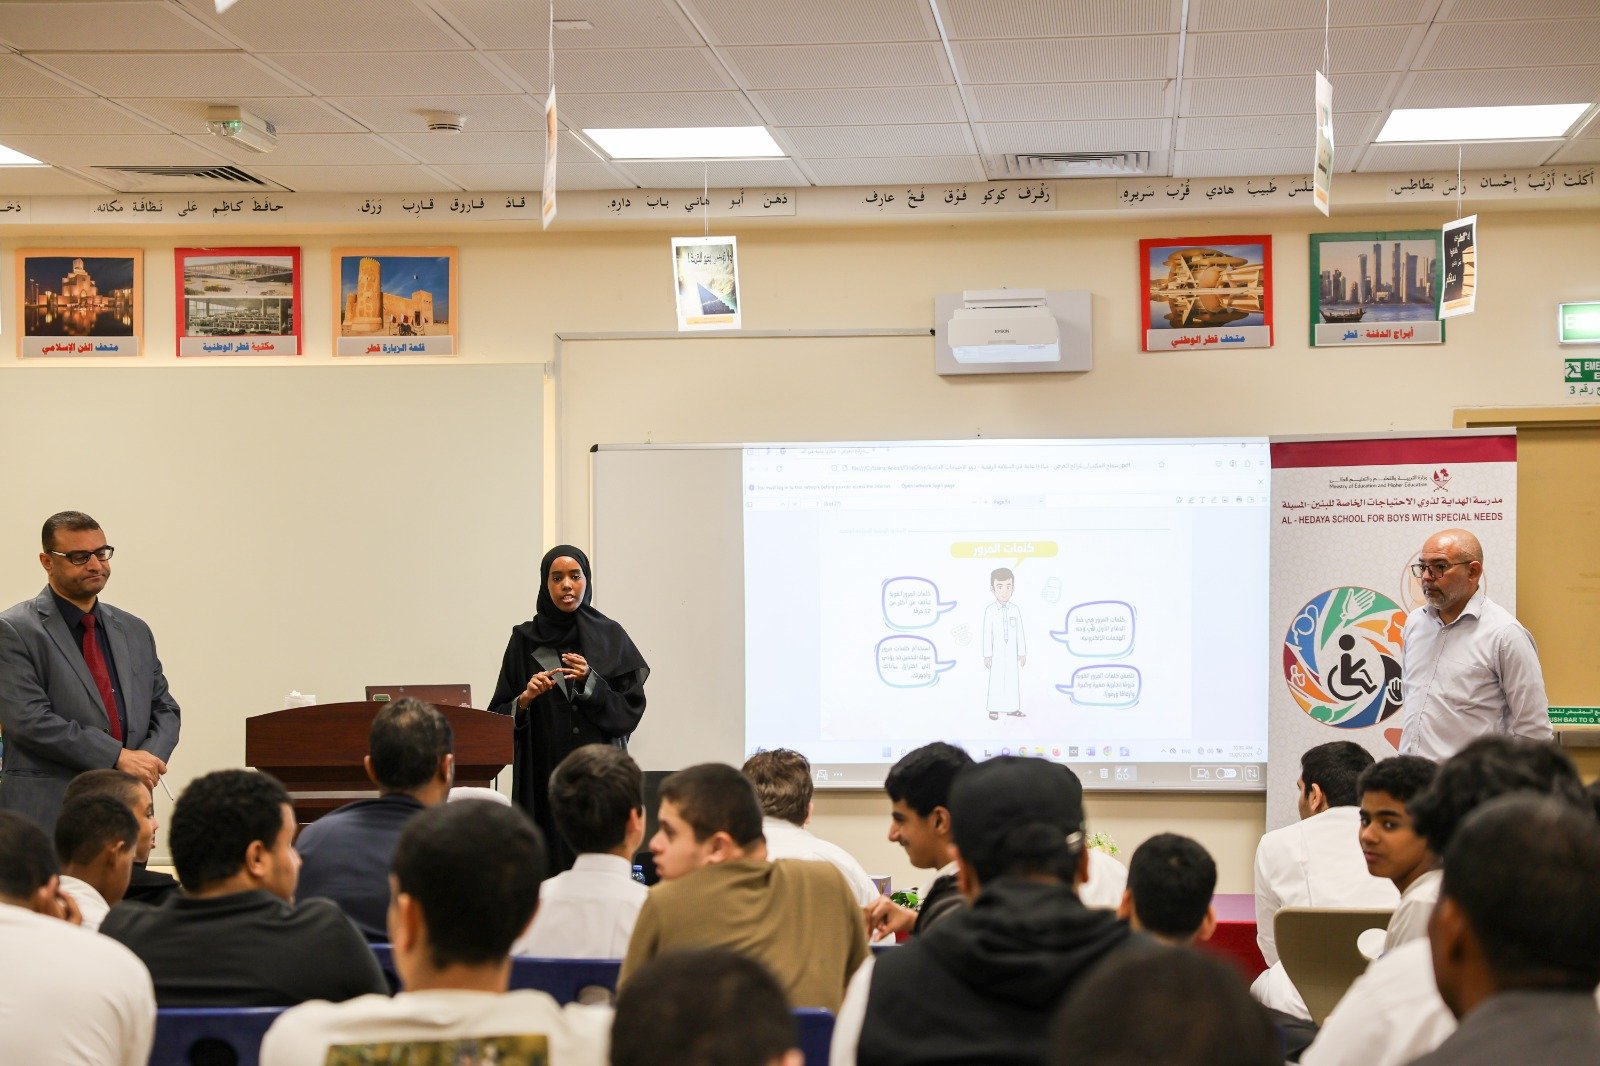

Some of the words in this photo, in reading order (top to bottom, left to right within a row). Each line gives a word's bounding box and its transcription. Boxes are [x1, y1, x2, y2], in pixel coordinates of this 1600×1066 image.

[981, 188, 1008, 205] كوكو
[1206, 184, 1235, 200] هادي
[450, 197, 485, 213] فاروق
[684, 196, 710, 212] هاني
[1341, 329, 1358, 341] قطر
[1366, 329, 1391, 339] الدفنة
[1393, 326, 1414, 339] أبراج
[1171, 335, 1201, 347] الوطني
[1202, 334, 1219, 345] قطر
[1220, 334, 1246, 343] متحف
[77, 342, 93, 353] الفن
[95, 342, 119, 351] متحف
[202, 342, 233, 352] الوطنية
[234, 342, 249, 352] قطر
[251, 341, 275, 352] مكتبة
[365, 344, 380, 354] قطر
[1584, 361, 1600, 371] EME
[1569, 385, 1576, 395] 3
[1336, 498, 1366, 508] الخاصة
[1367, 497, 1416, 508] الاحتياجات
[1417, 496, 1440, 508] لذوي
[1441, 496, 1472, 507] الهداية
[1473, 495, 1503, 506] مدرسة
[1281, 515, 1293, 525] AL
[1298, 515, 1331, 524] HEDAYA
[1332, 514, 1366, 523] SCHOOL
[1367, 514, 1385, 523] FOR
[1387, 513, 1410, 522] BOYS
[1412, 513, 1434, 522] WITH
[1435, 512, 1472, 522] SPECIAL
[1474, 512, 1503, 521] NEEDS
[973, 543, 1000, 558] المرور
[1003, 543, 1035, 554] كلمات
